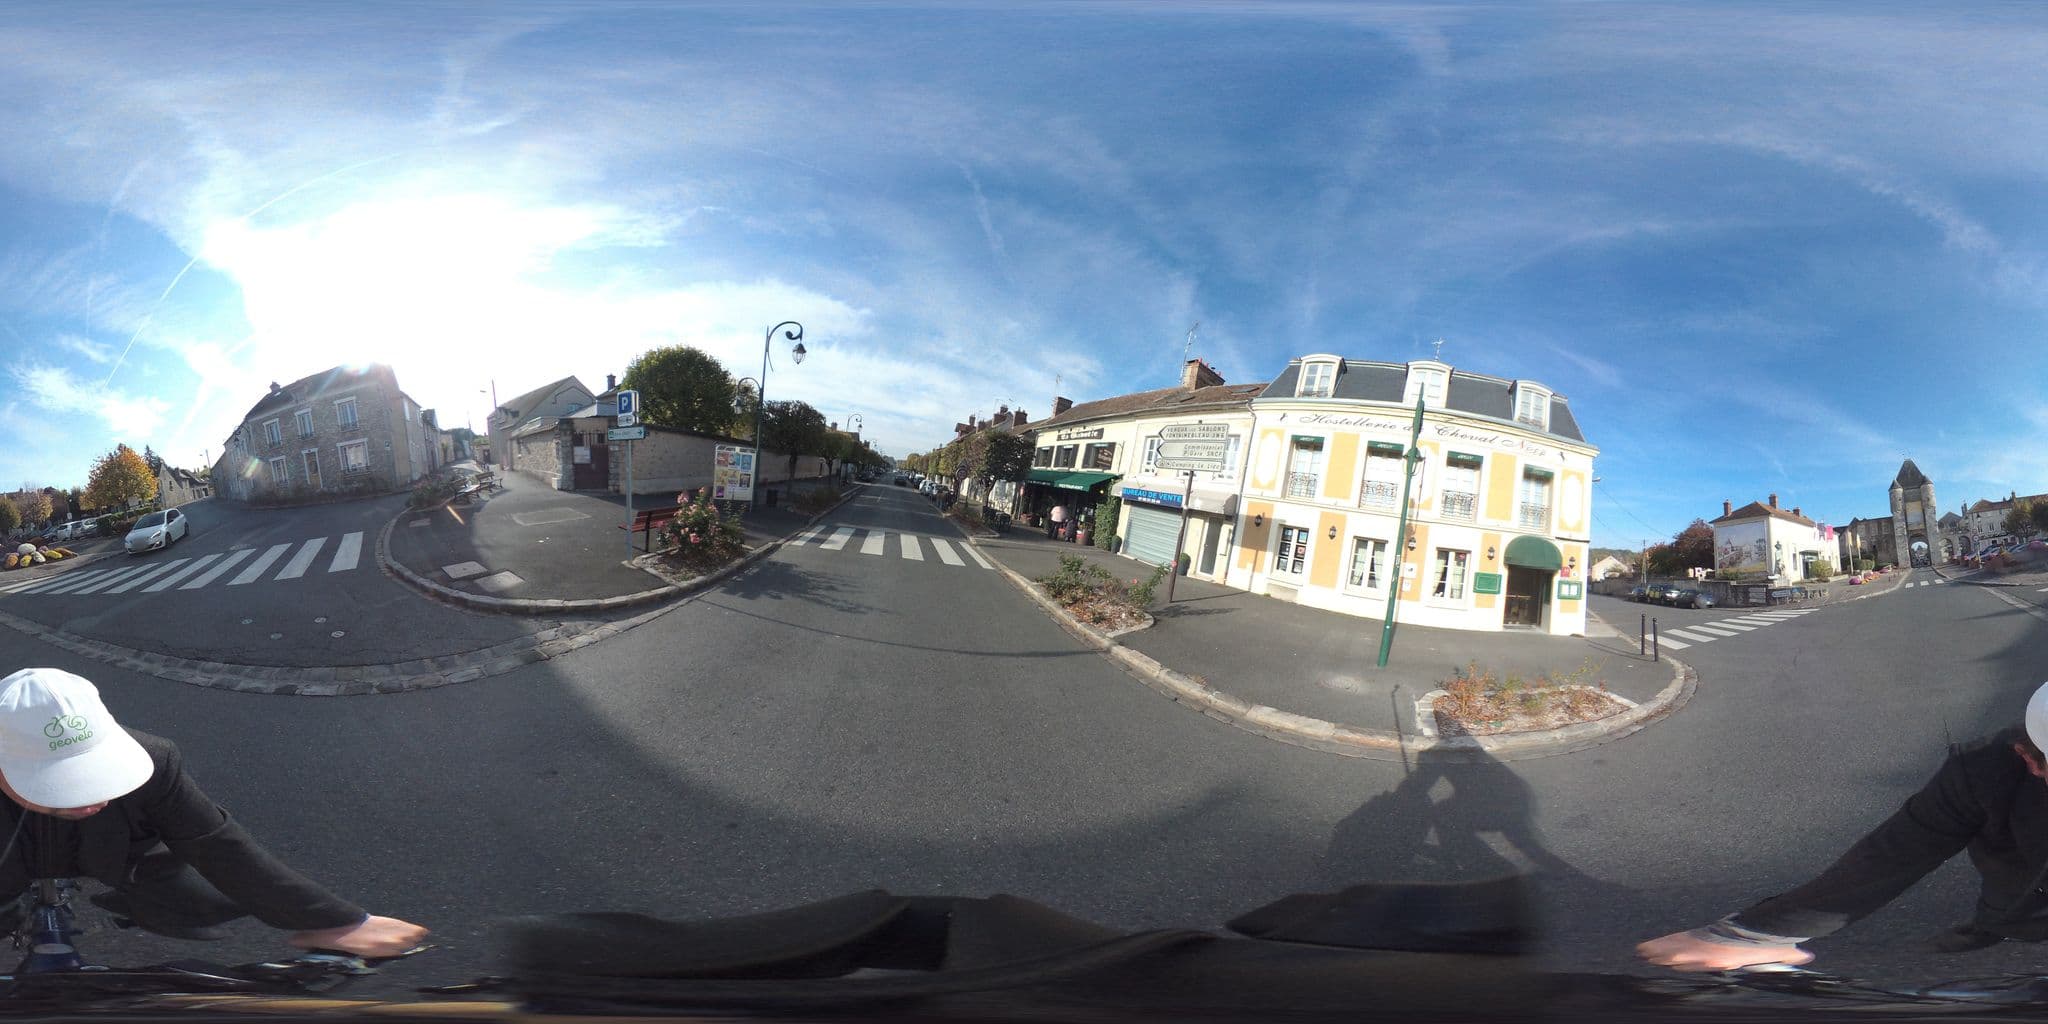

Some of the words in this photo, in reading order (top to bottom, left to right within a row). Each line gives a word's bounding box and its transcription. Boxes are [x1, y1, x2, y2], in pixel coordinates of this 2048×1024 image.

[621, 397, 629, 411] P
[1299, 413, 1397, 430] Hostellerie
[1434, 425, 1498, 444] Cheval
[1123, 488, 1146, 497] BUREAU
[1159, 493, 1182, 503] VENTE
[48, 730, 94, 751] geovelo
